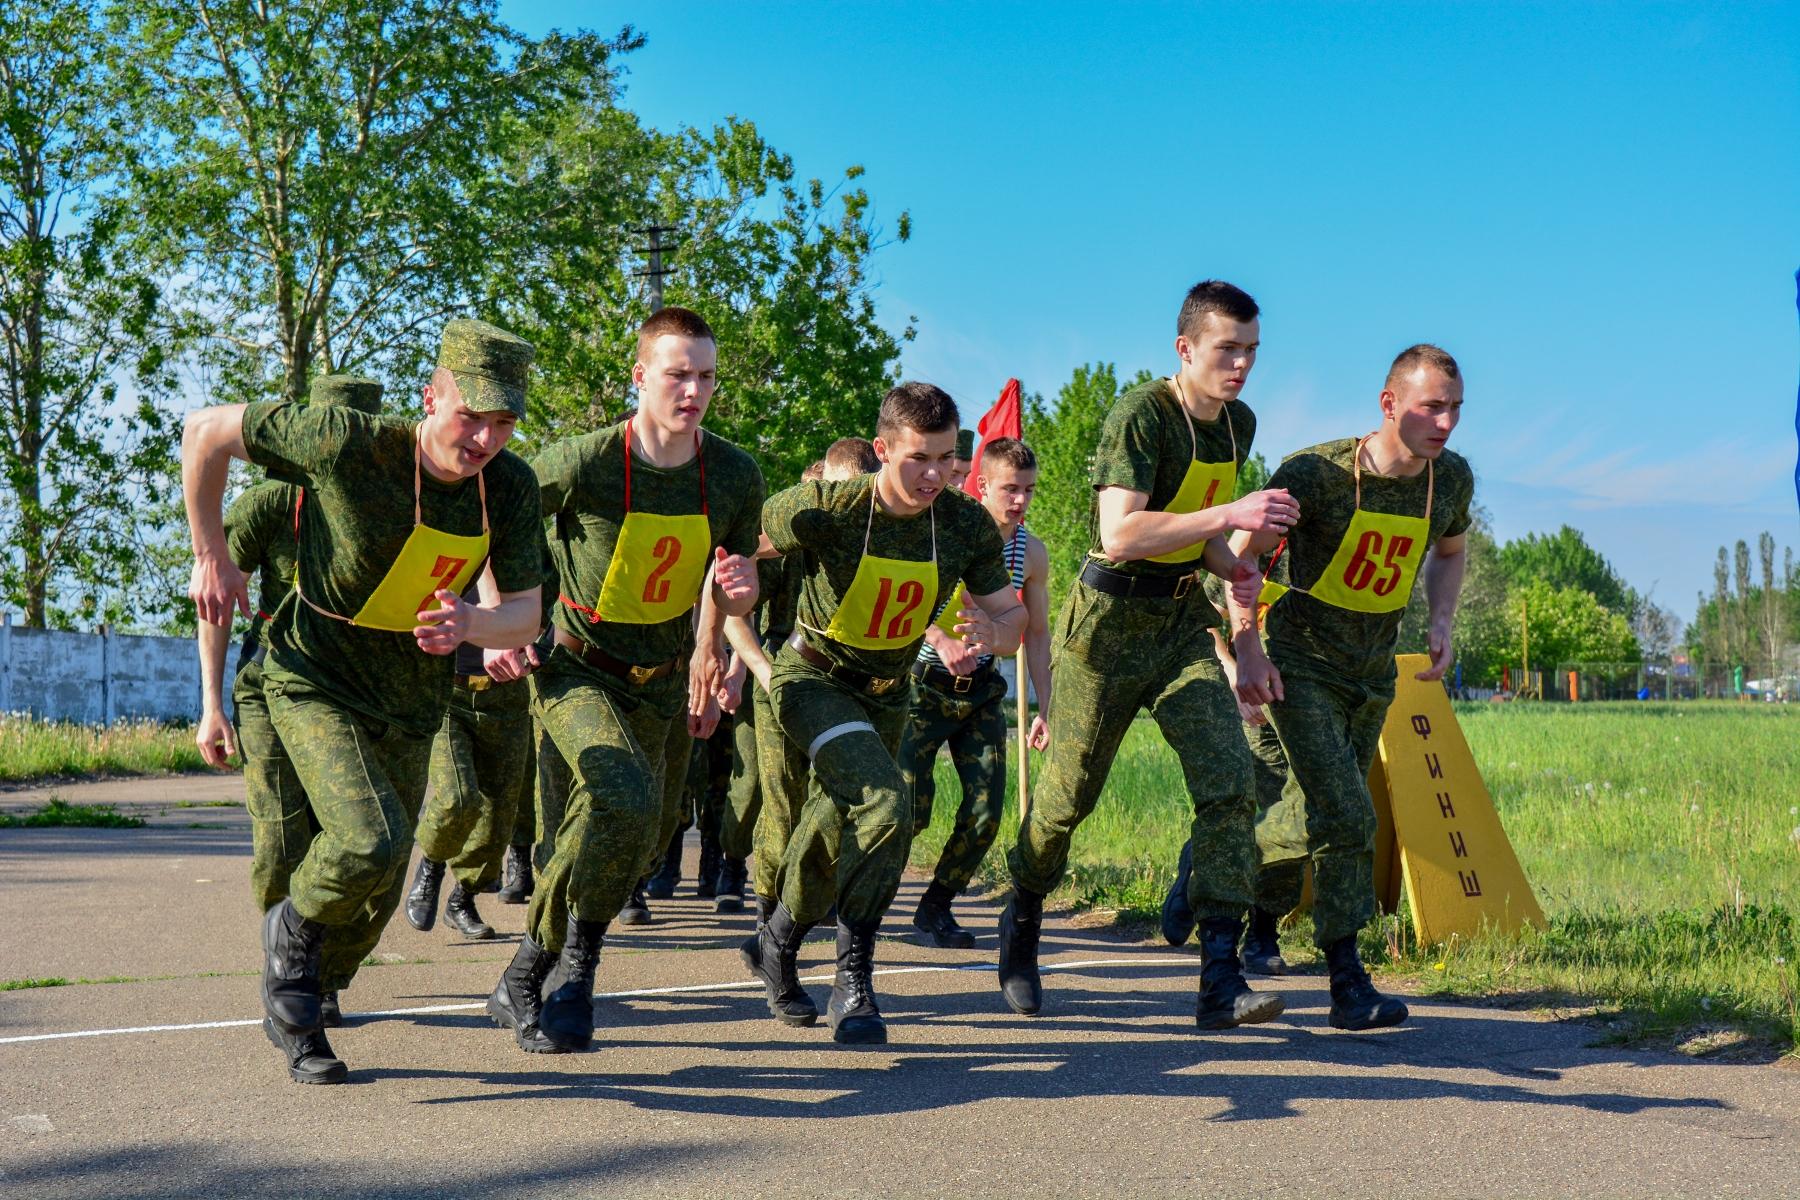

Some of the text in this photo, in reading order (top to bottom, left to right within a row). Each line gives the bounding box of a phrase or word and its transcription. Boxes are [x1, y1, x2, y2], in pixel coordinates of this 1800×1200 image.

[415, 555, 468, 615] 7
[642, 535, 682, 603] 2
[1343, 530, 1414, 597] 65
[864, 577, 925, 640] 12
[1411, 714, 1482, 897] ФИНИШ
